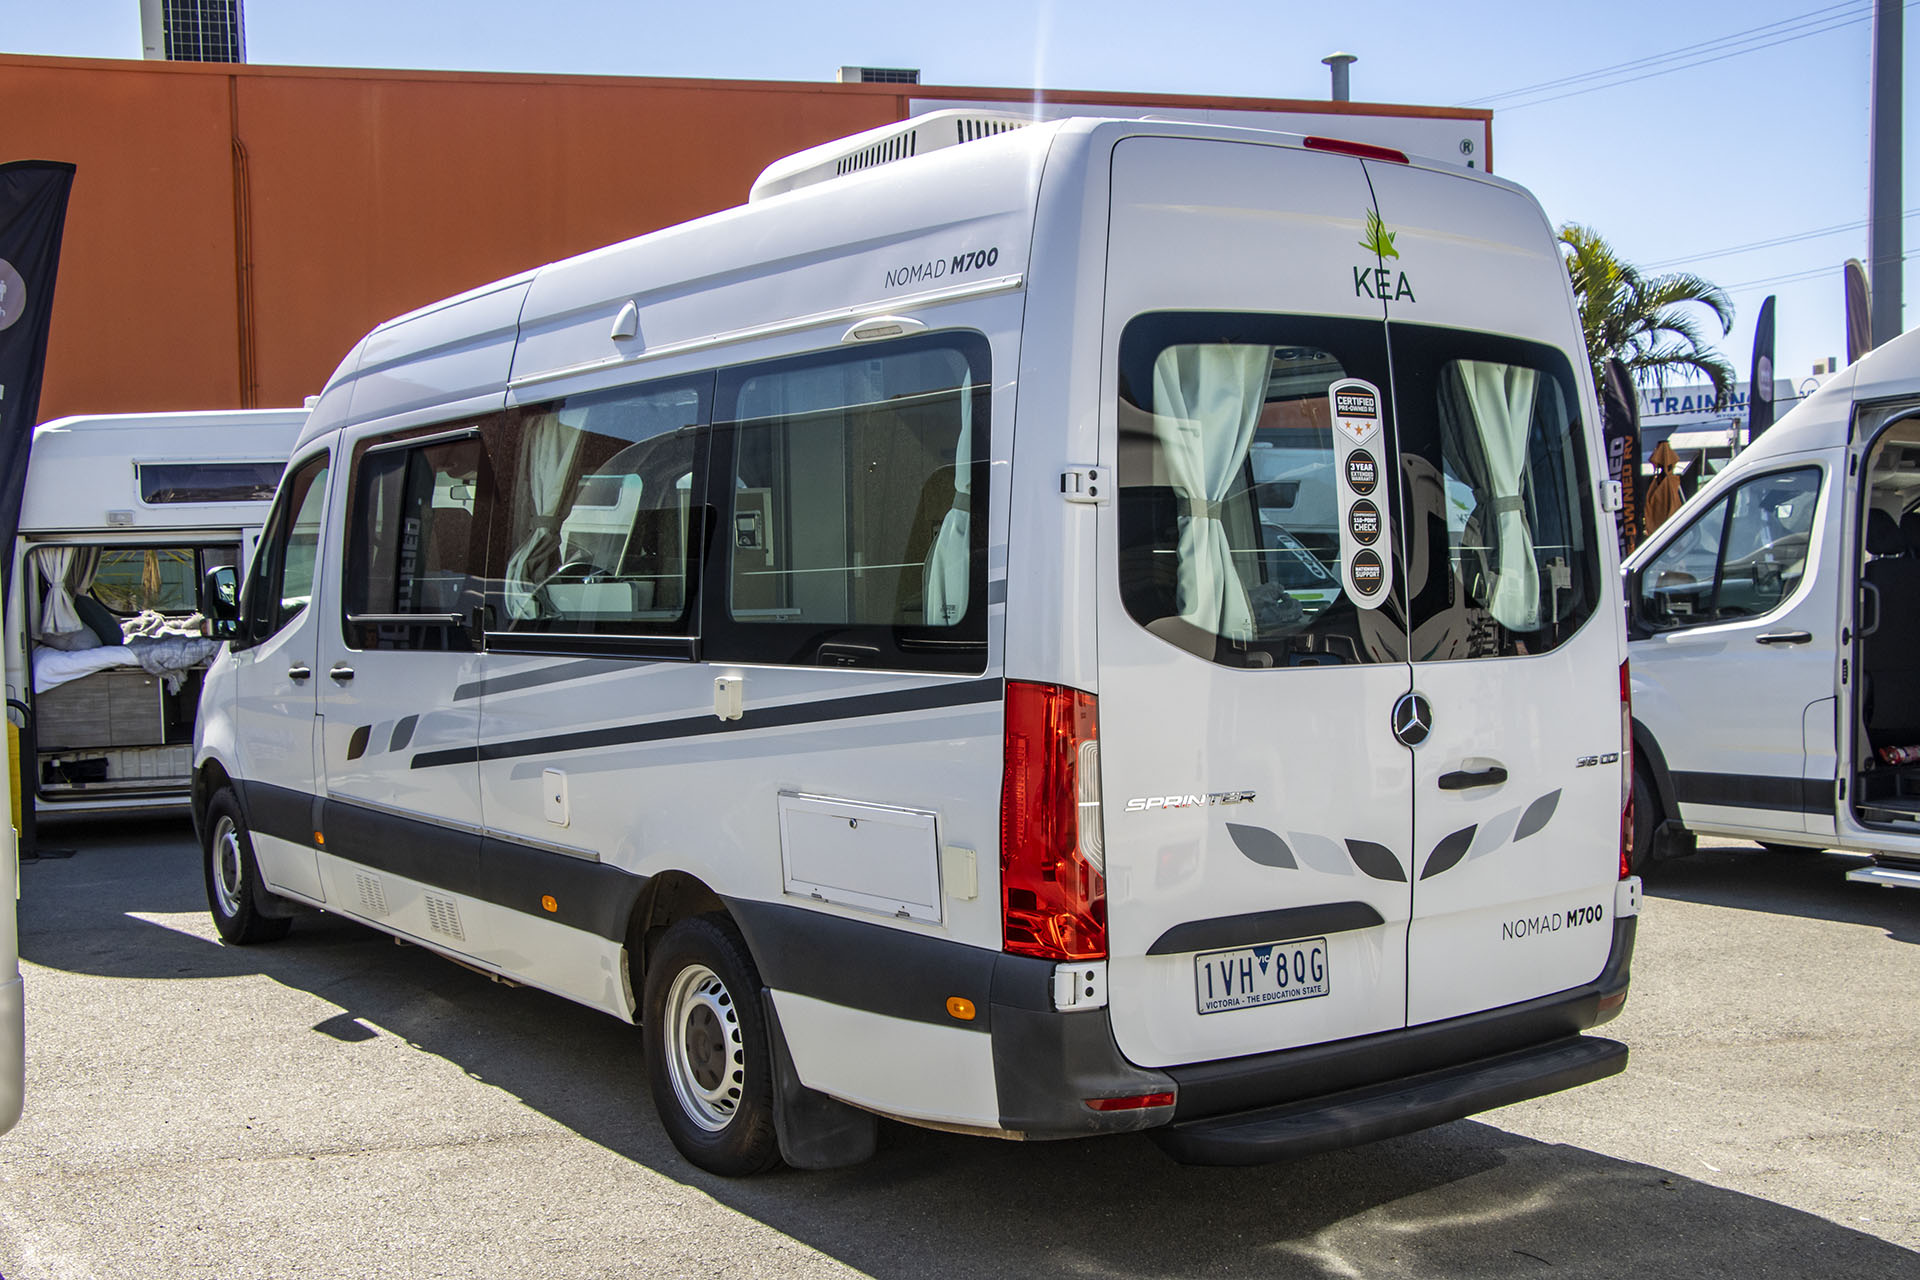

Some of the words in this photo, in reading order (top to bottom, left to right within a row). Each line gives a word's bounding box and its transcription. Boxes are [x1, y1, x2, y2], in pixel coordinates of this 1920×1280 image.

[885, 259, 946, 288] NOMAD
[950, 247, 998, 275] M700
[1353, 266, 1416, 303] KEA
[1337, 396, 1374, 406] CERTIFIED
[1650, 391, 1751, 414] TRAINN
[1623, 435, 1634, 459] RV
[1350, 463, 1355, 471] 3
[1356, 463, 1373, 471] YEAR
[1354, 523, 1377, 531] CHECK
[1124, 790, 1257, 812] SPRINTER
[1502, 913, 1562, 941] NOMAD
[1566, 904, 1603, 929] M700
[1257, 954, 1270, 963] VIC
[1204, 957, 1254, 999] 1VH
[1276, 948, 1323, 988] 8QG
[1206, 997, 1240, 1010] VICTORIA
[1247, 994, 1261, 1004] THE
[1262, 989, 1301, 1002] EDUCATION
[1302, 984, 1322, 996] STATE
